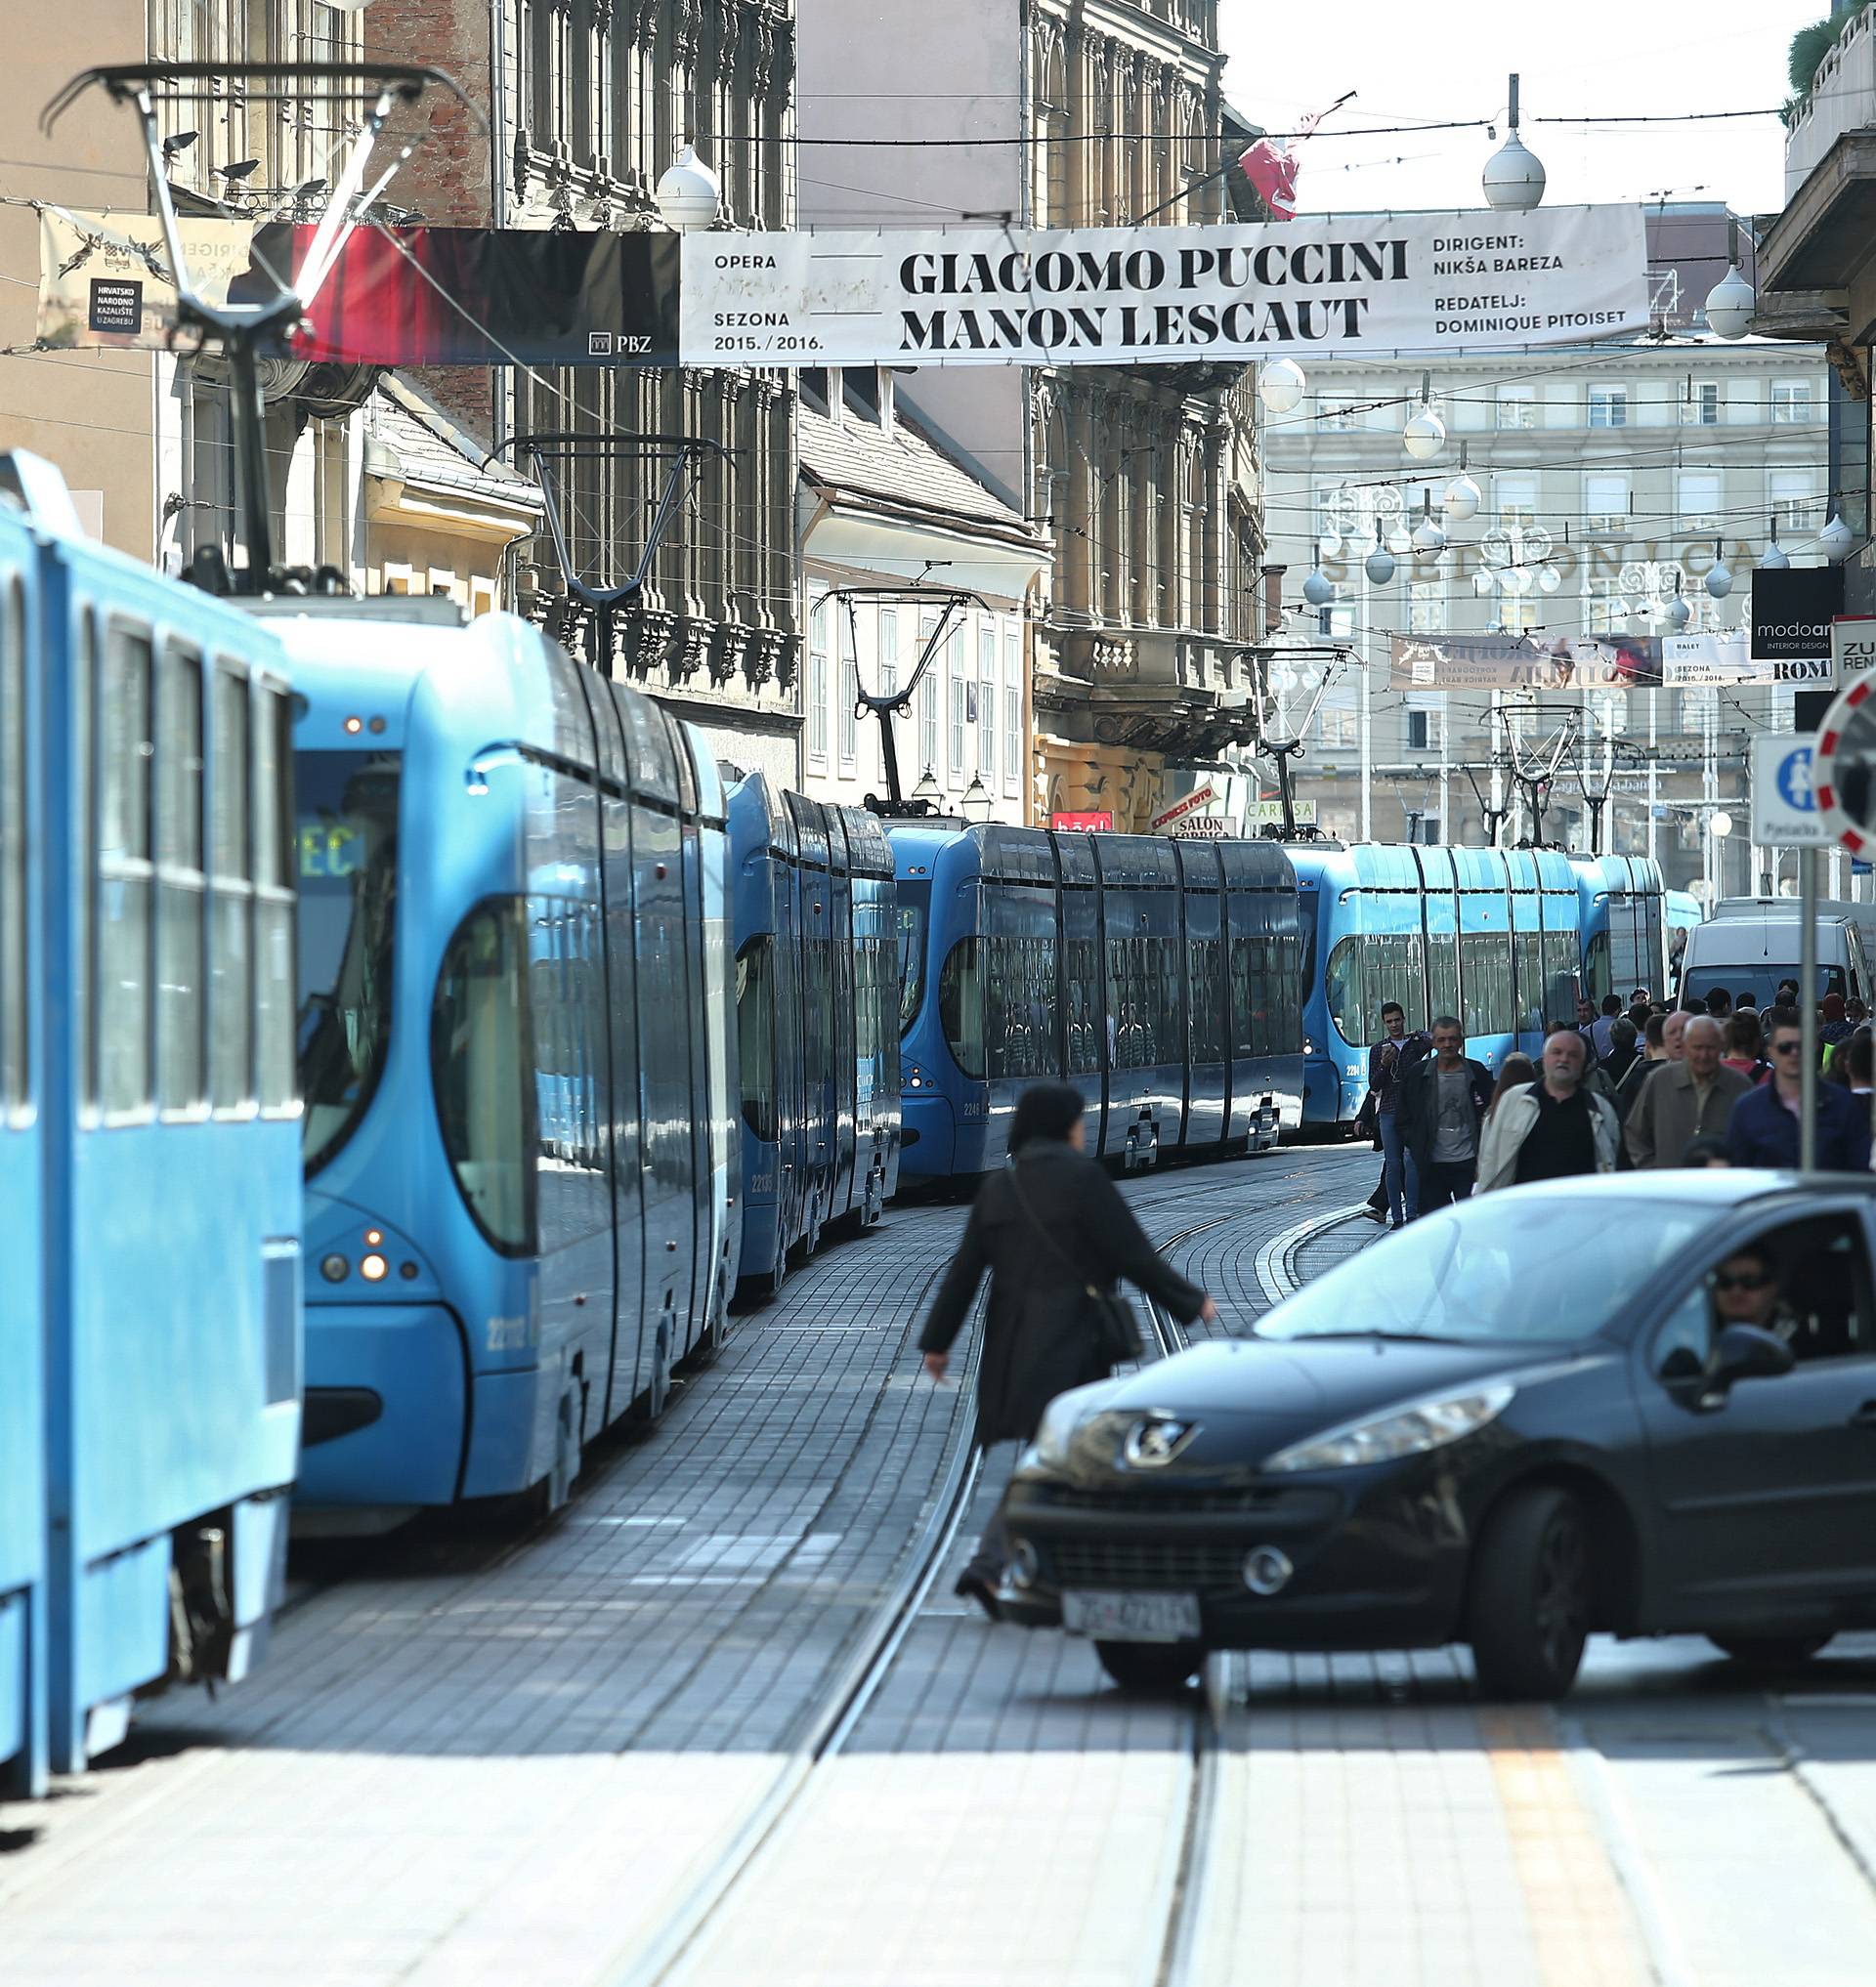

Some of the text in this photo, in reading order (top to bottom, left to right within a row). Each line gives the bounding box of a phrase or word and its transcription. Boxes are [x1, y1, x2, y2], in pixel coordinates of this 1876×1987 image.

[1433, 235, 1524, 252] DIRIGENT:
[714, 255, 777, 269] OPERA
[899, 239, 1409, 295] GIACOMO PUCCINI
[1433, 255, 1563, 275] NIKŠA BAREZA
[98, 286, 135, 296] HRVATSKO
[98, 296, 134, 306] NARODNO
[1434, 294, 1526, 312] REDATELJ:
[97, 307, 133, 316] KAZALIŠTE
[714, 313, 789, 327] SEZONA
[899, 297, 1368, 351] MANON LESCAUT
[1435, 311, 1626, 334] DOMINIQUE PITOISET
[618, 336, 652, 353] PBZ
[1188, 788, 1212, 807] FOTO
[1248, 803, 1312, 817] CARSA
[1179, 817, 1223, 831] SALON
